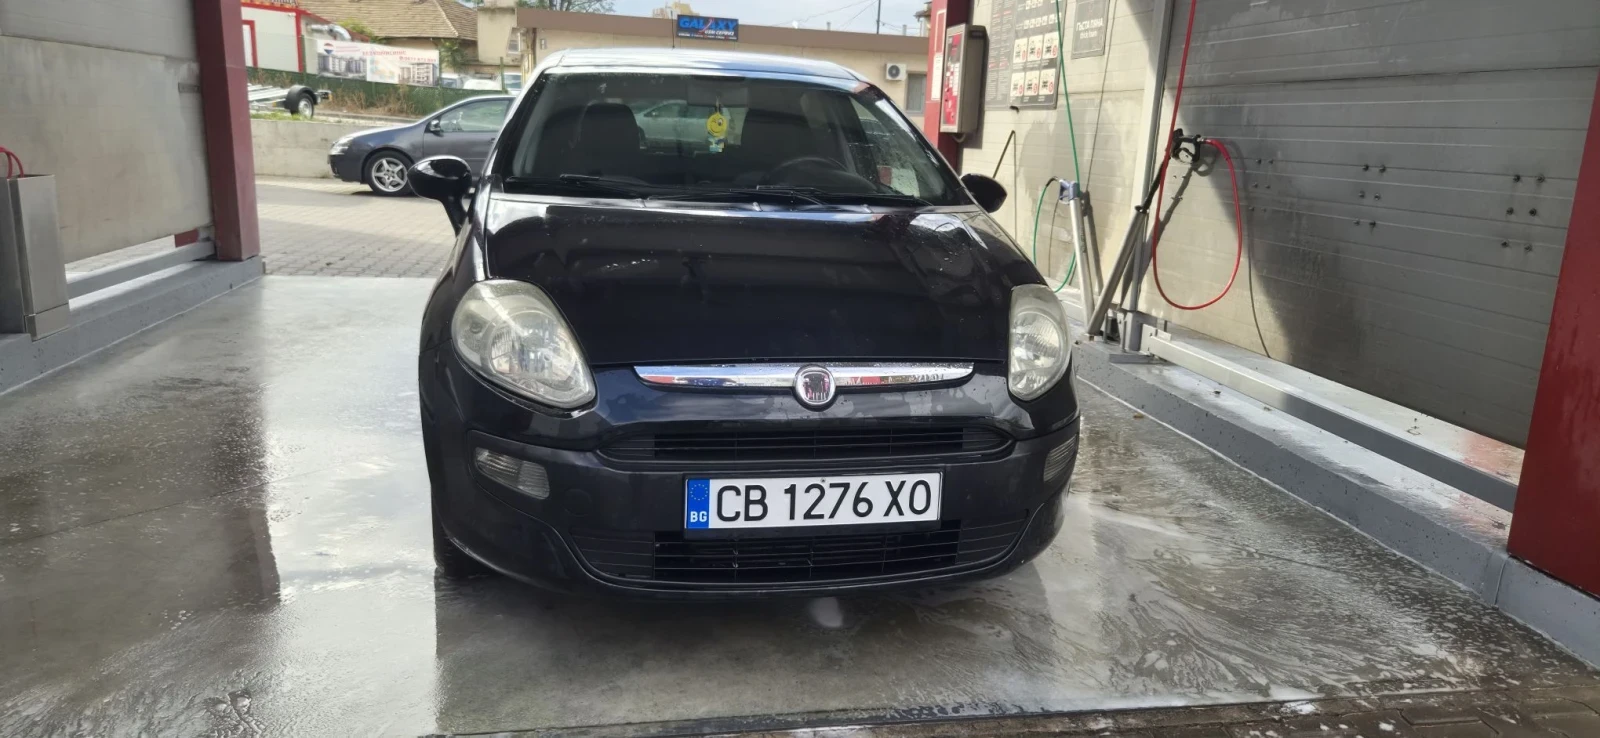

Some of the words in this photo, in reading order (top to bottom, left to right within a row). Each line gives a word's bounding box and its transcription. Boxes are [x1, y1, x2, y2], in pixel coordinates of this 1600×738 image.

[679, 17, 737, 31] GALAXY
[716, 484, 769, 522] CB
[784, 482, 874, 521] 1276
[883, 479, 932, 517] XO
[690, 511, 708, 523] BG
